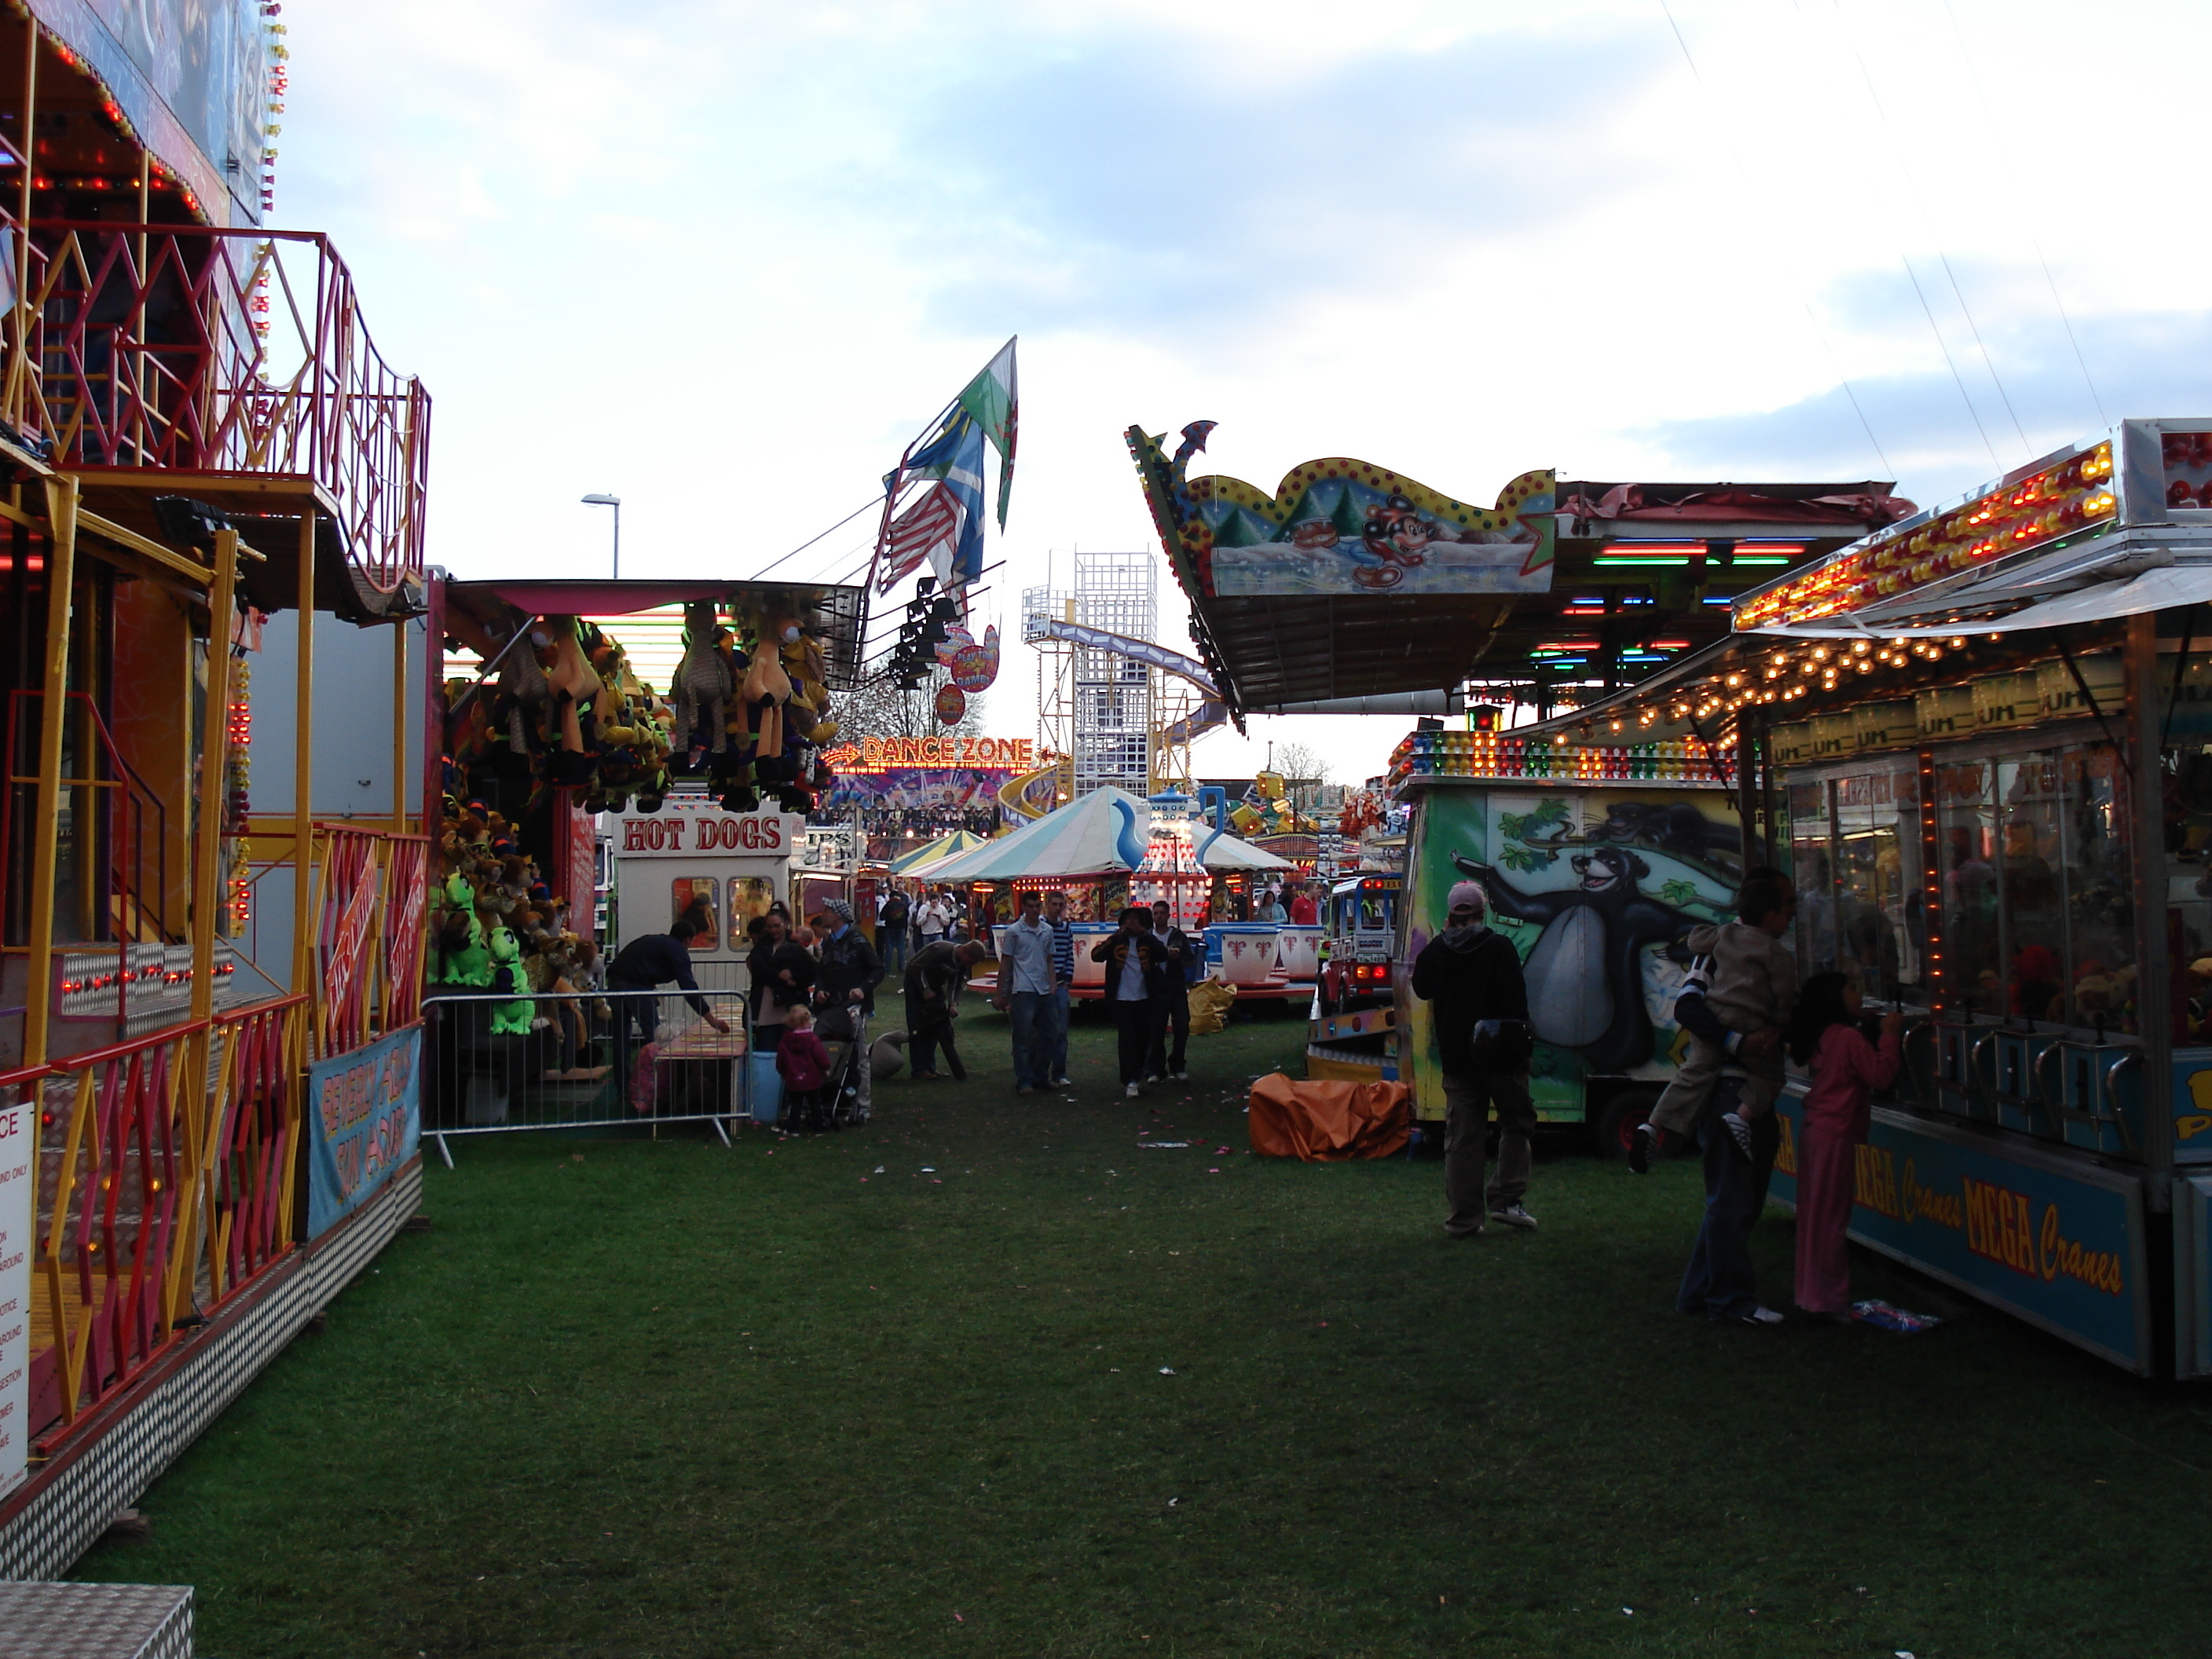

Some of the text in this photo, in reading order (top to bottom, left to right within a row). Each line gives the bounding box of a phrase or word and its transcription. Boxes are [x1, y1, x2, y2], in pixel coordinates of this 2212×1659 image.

[958, 651, 976, 662] PLAY
[864, 736, 1034, 764] DANCE ZONE
[623, 818, 685, 851] HOT
[696, 817, 781, 850] DOGS
[13, 1164, 28, 1179] ONLY
[1902, 1156, 1962, 1230] Cranes
[1963, 1175, 2122, 1297] MEGA Cranes
